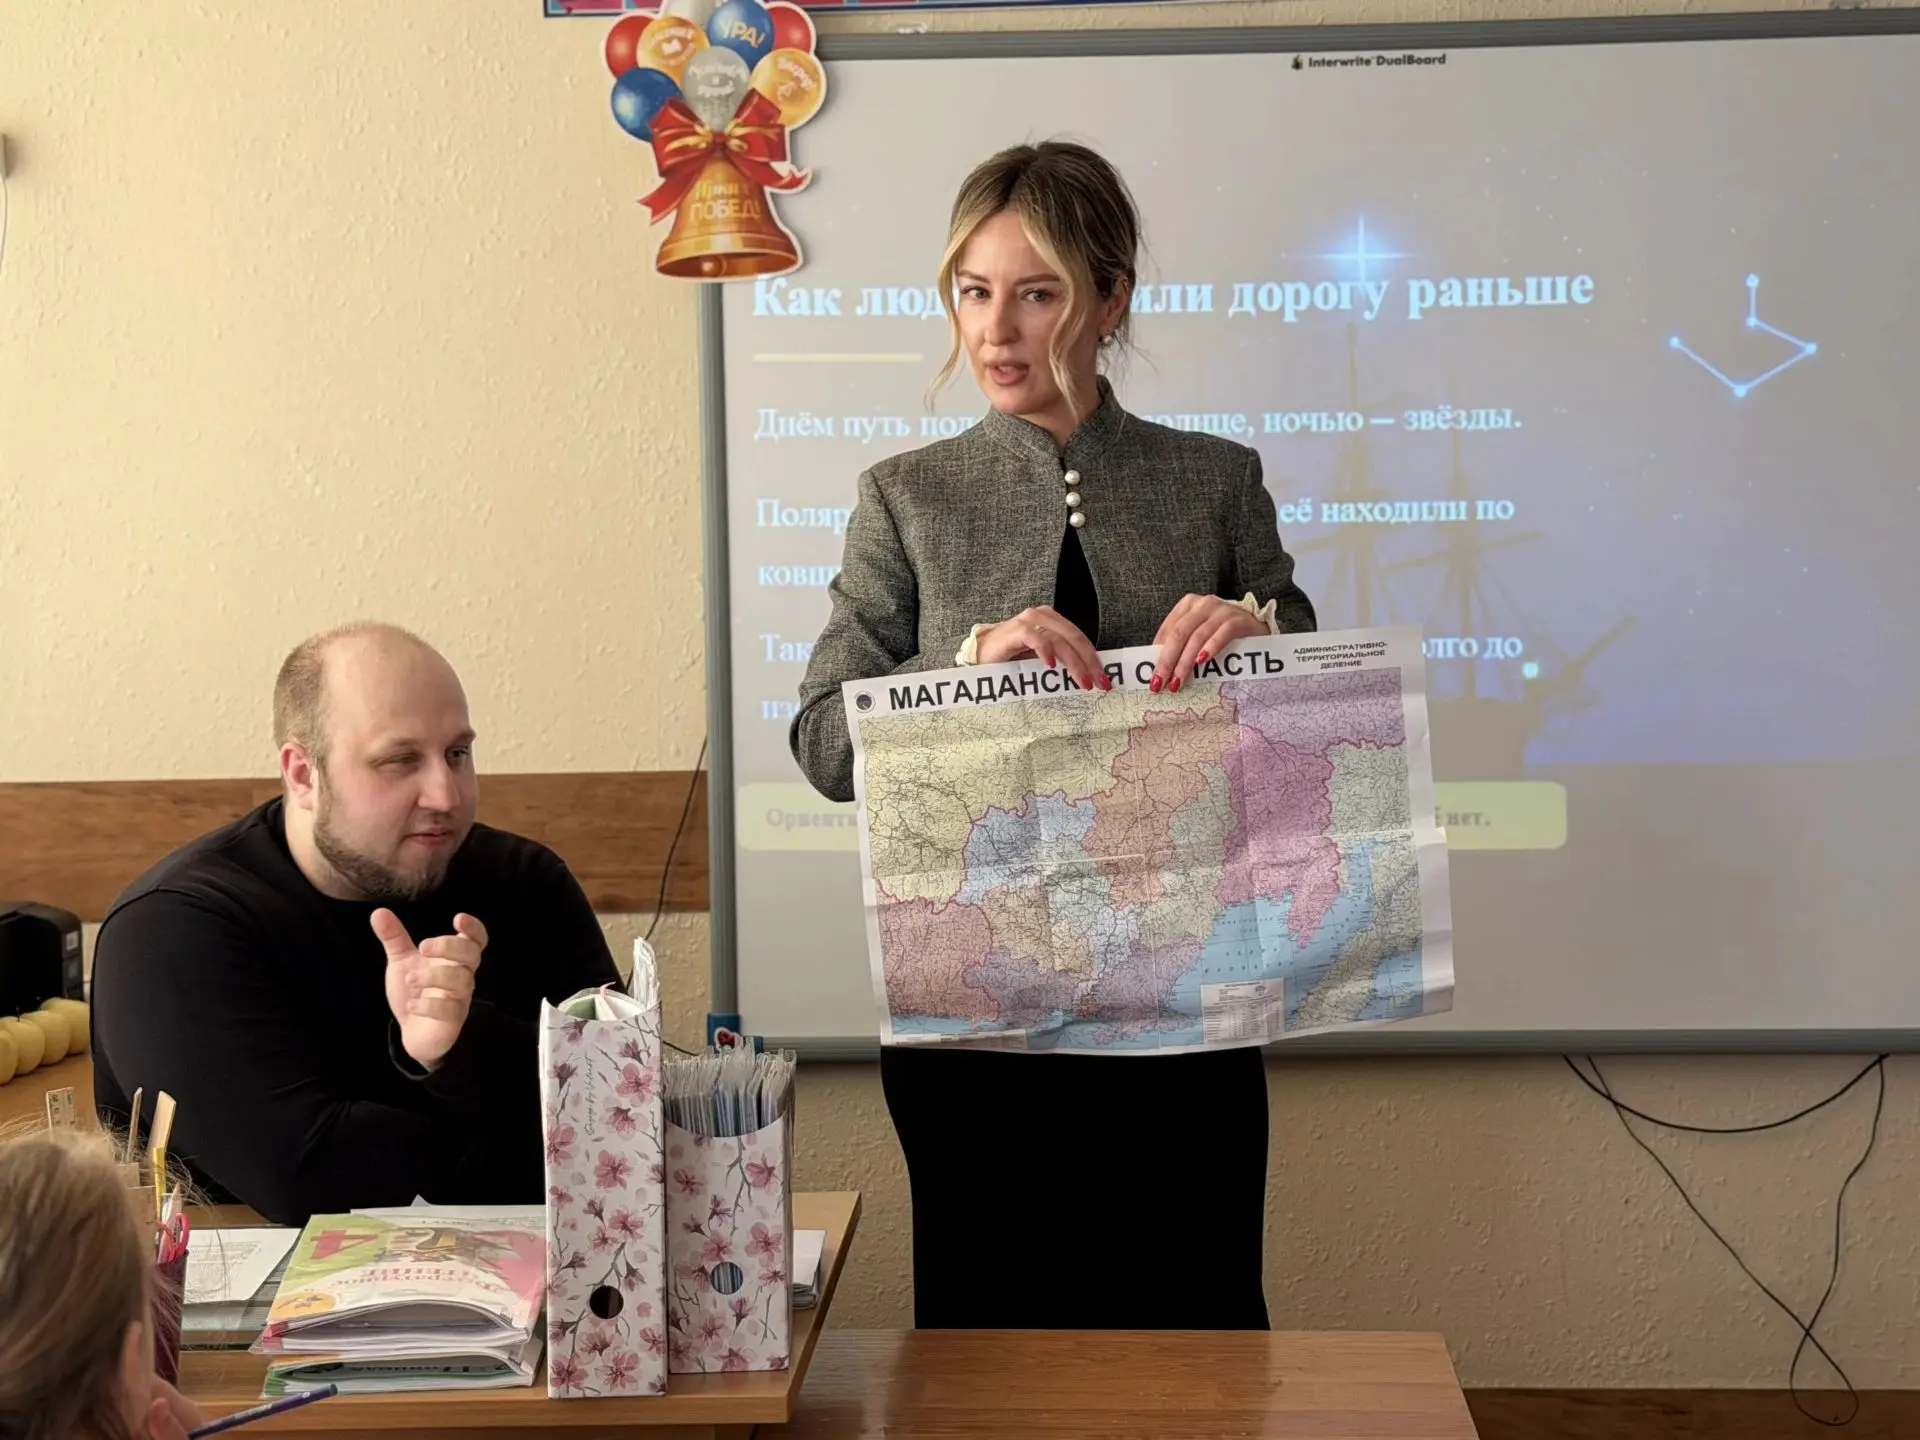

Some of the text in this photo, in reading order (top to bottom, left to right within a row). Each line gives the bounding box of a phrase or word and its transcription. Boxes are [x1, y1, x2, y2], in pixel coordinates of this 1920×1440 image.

[719, 20, 766, 48] УРА!
[1376, 53, 1447, 66] DualBoard
[752, 274, 1594, 323] Как люд или дорогу раньше
[753, 408, 835, 441] Днём
[843, 416, 910, 444] путь
[1263, 411, 1364, 433] ночью
[1403, 403, 1522, 432] звёзды.
[757, 498, 1515, 535] Поляр её находили по
[758, 565, 840, 586] ковш
[1293, 641, 1388, 654] АДМИНИСТРАТИВНО-
[1296, 650, 1385, 663] ТЕРРИТОРИАЛЬНОЕ
[1422, 637, 1478, 659] лго
[1483, 637, 1523, 660] до
[1320, 660, 1363, 670] ДЕЛЕНИЕ
[889, 651, 1284, 710] МАГАДАНСКЯ ОАСТЬ
[766, 807, 858, 832] Ориенти
[310, 1229, 378, 1261] 4
